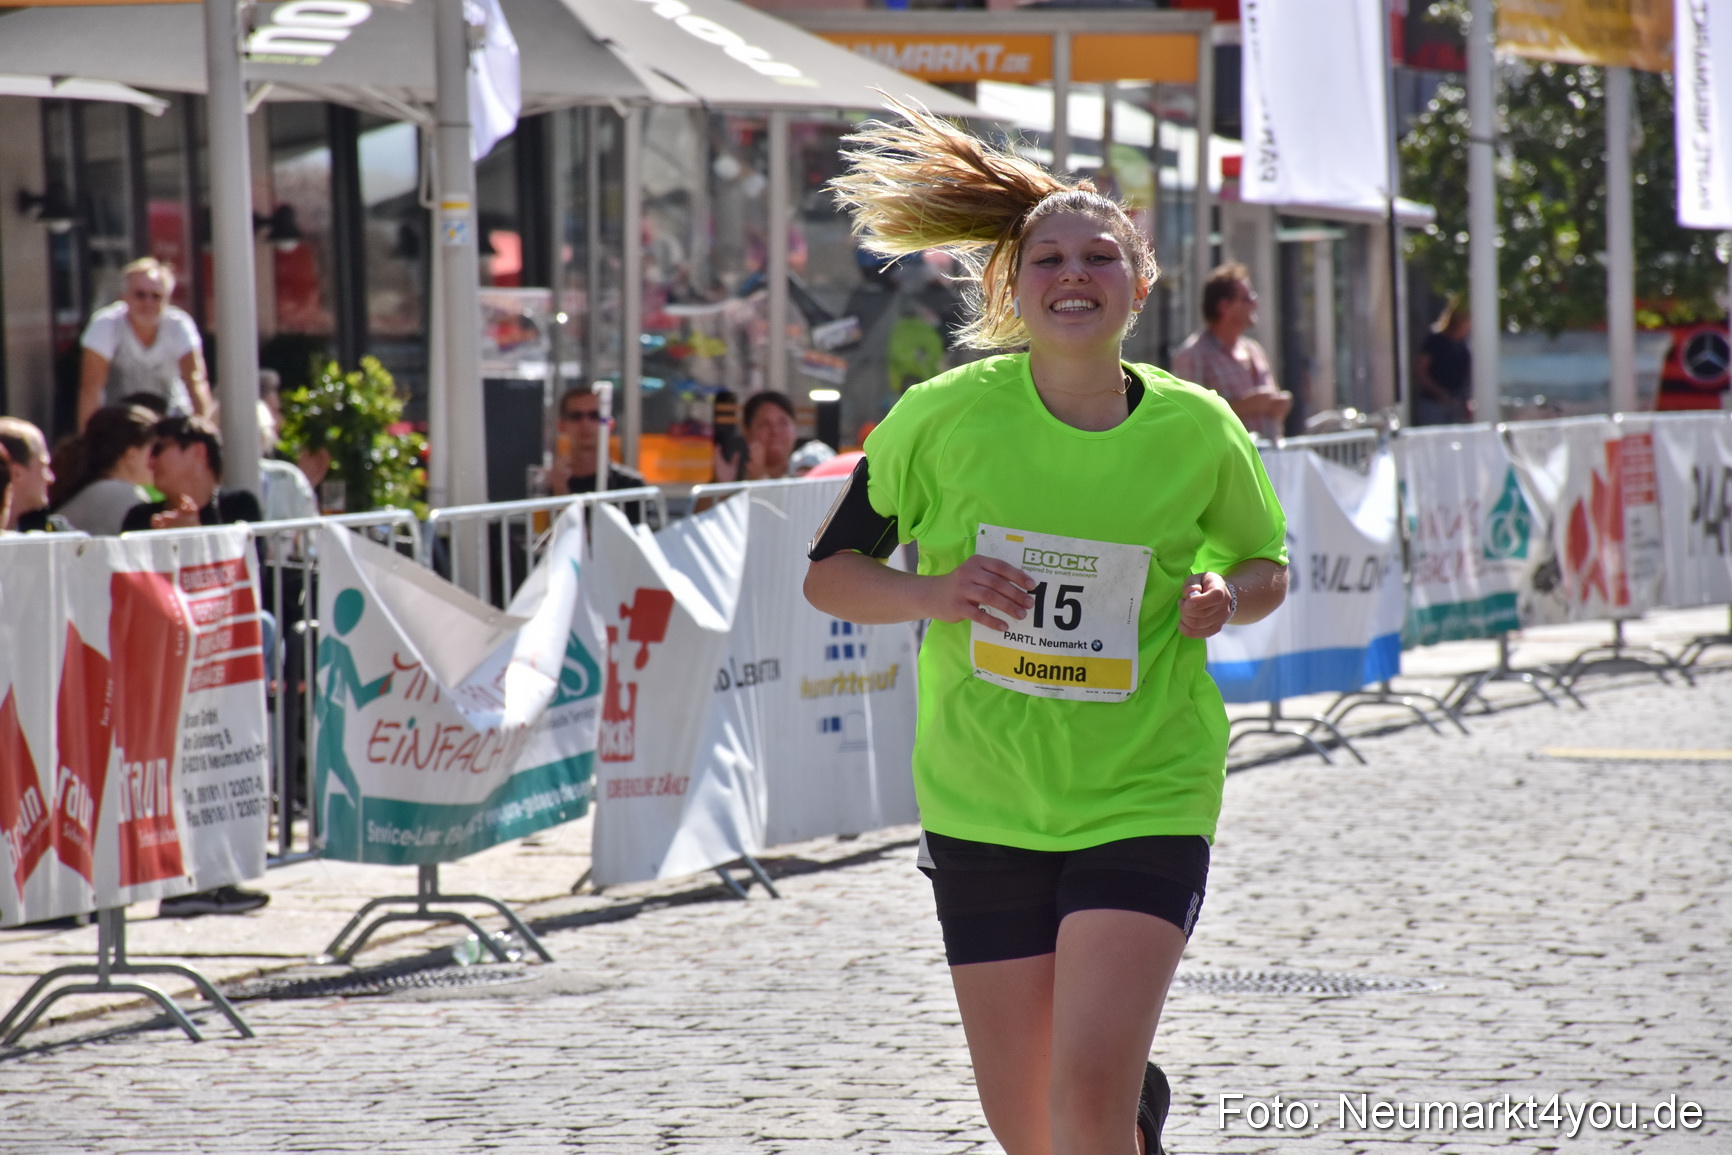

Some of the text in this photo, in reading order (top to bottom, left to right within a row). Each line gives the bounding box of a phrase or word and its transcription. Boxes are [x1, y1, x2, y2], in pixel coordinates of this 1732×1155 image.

[1021, 565, 1045, 575] inspired
[1054, 569, 1071, 577] smart
[1022, 547, 1099, 573] BOCK
[1027, 581, 1084, 631] 15
[1003, 631, 1088, 650] PARTL Neumarkt
[1013, 656, 1087, 682] Joanna
